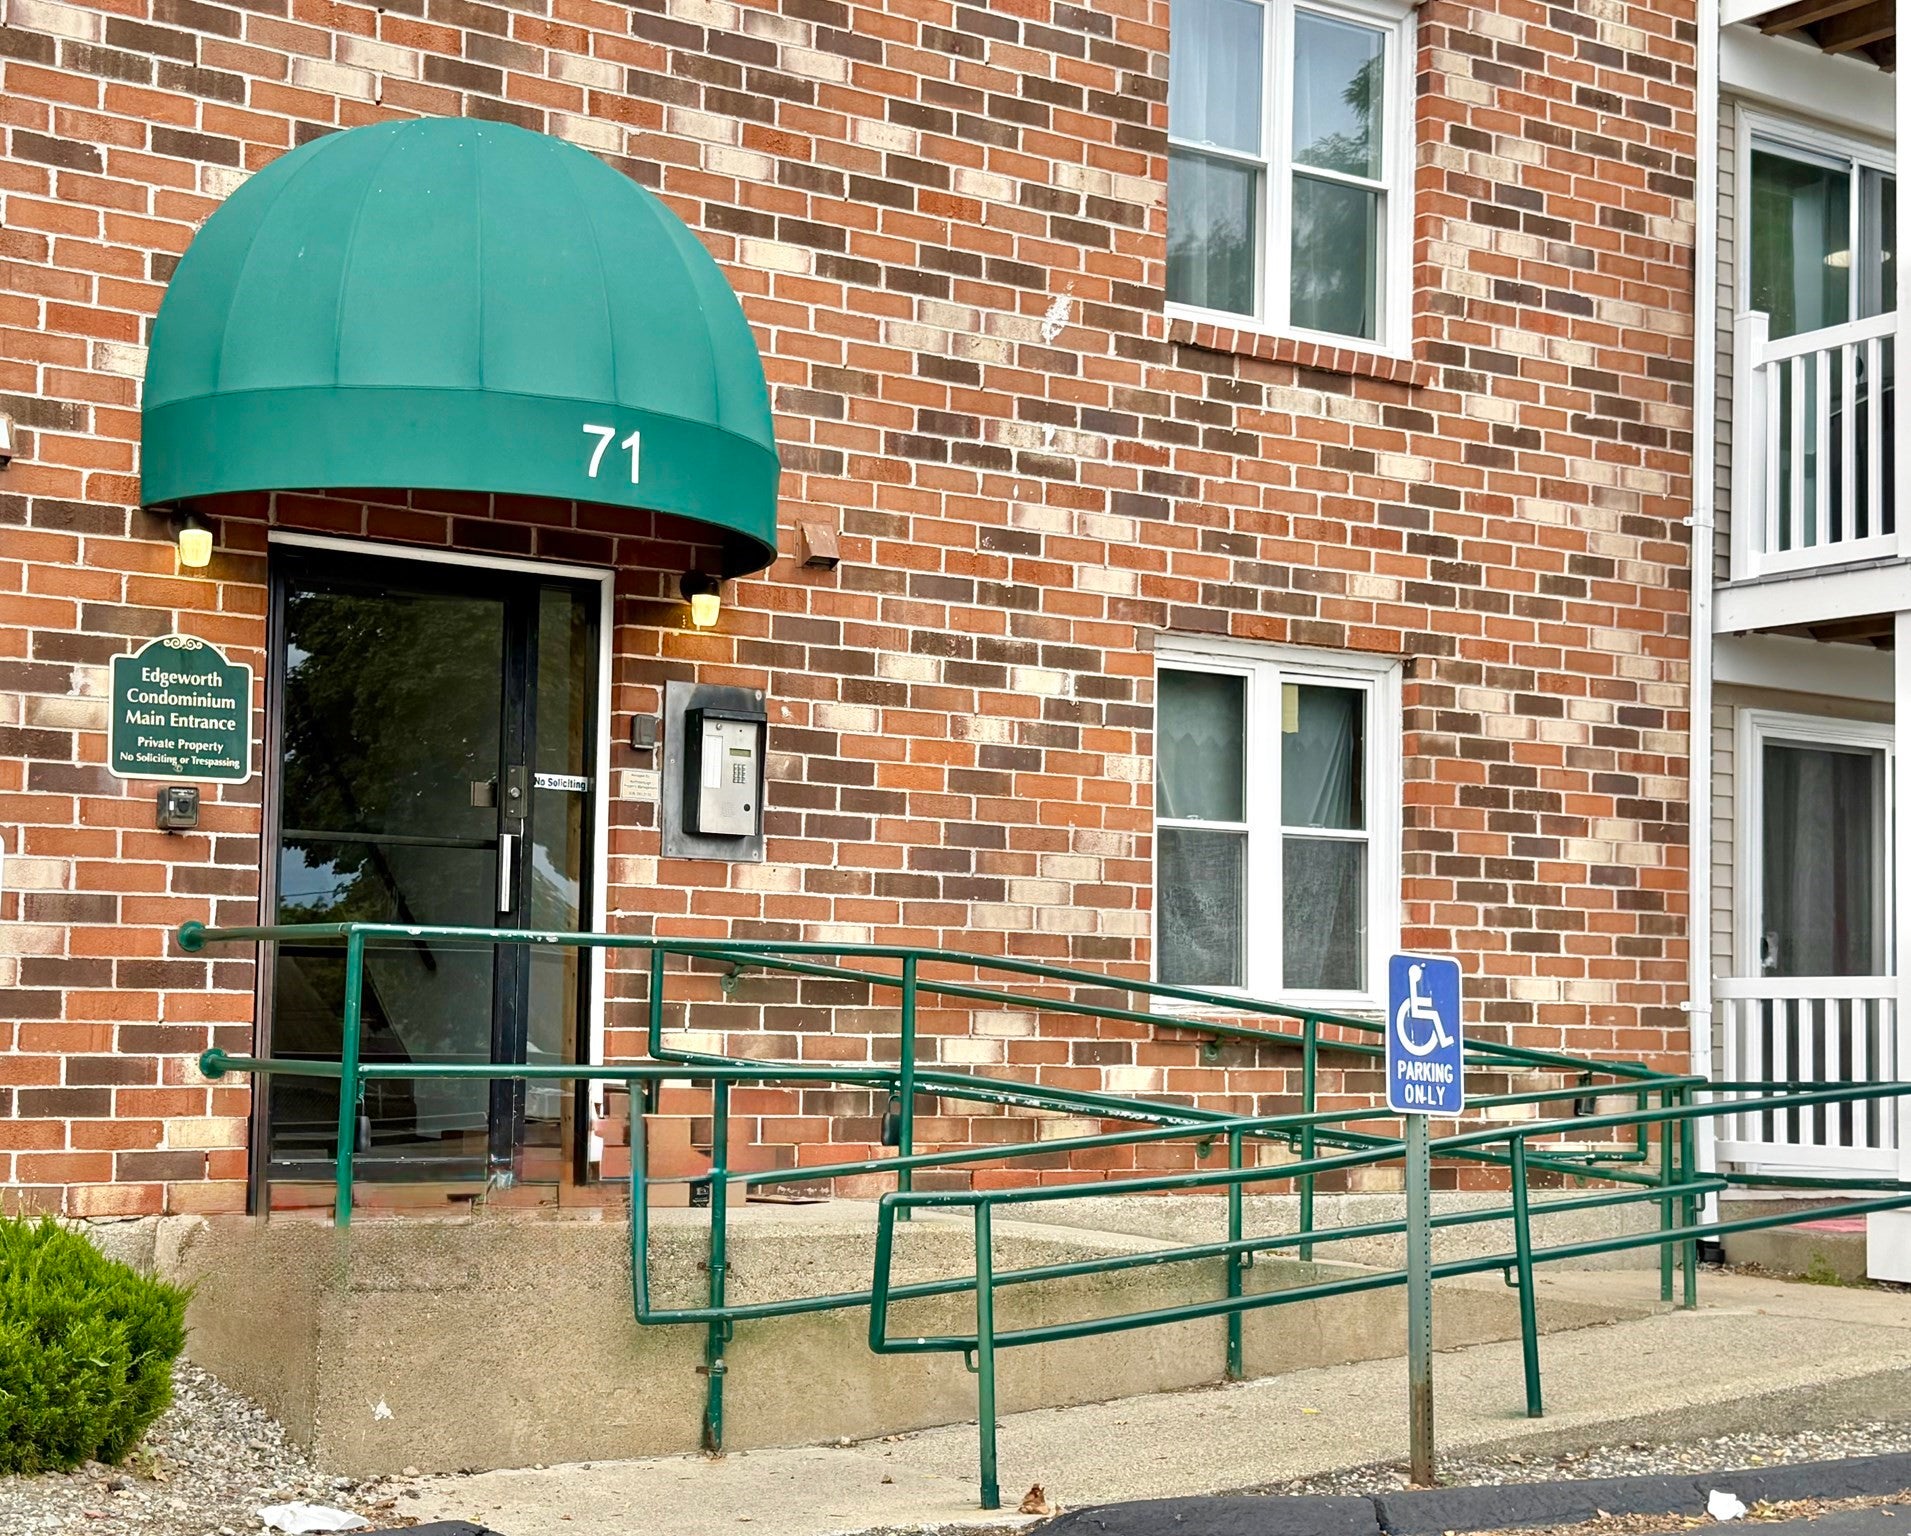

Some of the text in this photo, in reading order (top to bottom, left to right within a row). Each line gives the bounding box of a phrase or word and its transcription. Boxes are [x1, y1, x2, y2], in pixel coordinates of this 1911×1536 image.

[582, 423, 640, 484] 71
[141, 667, 222, 687] Edgeworth
[127, 688, 236, 709] Condominium
[125, 709, 236, 731] Main Entrance
[137, 736, 224, 754] Private Property
[120, 751, 240, 770] No Soliciting or Trespassing
[534, 776, 586, 791] No Soliciting
[1397, 1060, 1453, 1084] PARKING
[1404, 1083, 1446, 1106] ONLY
